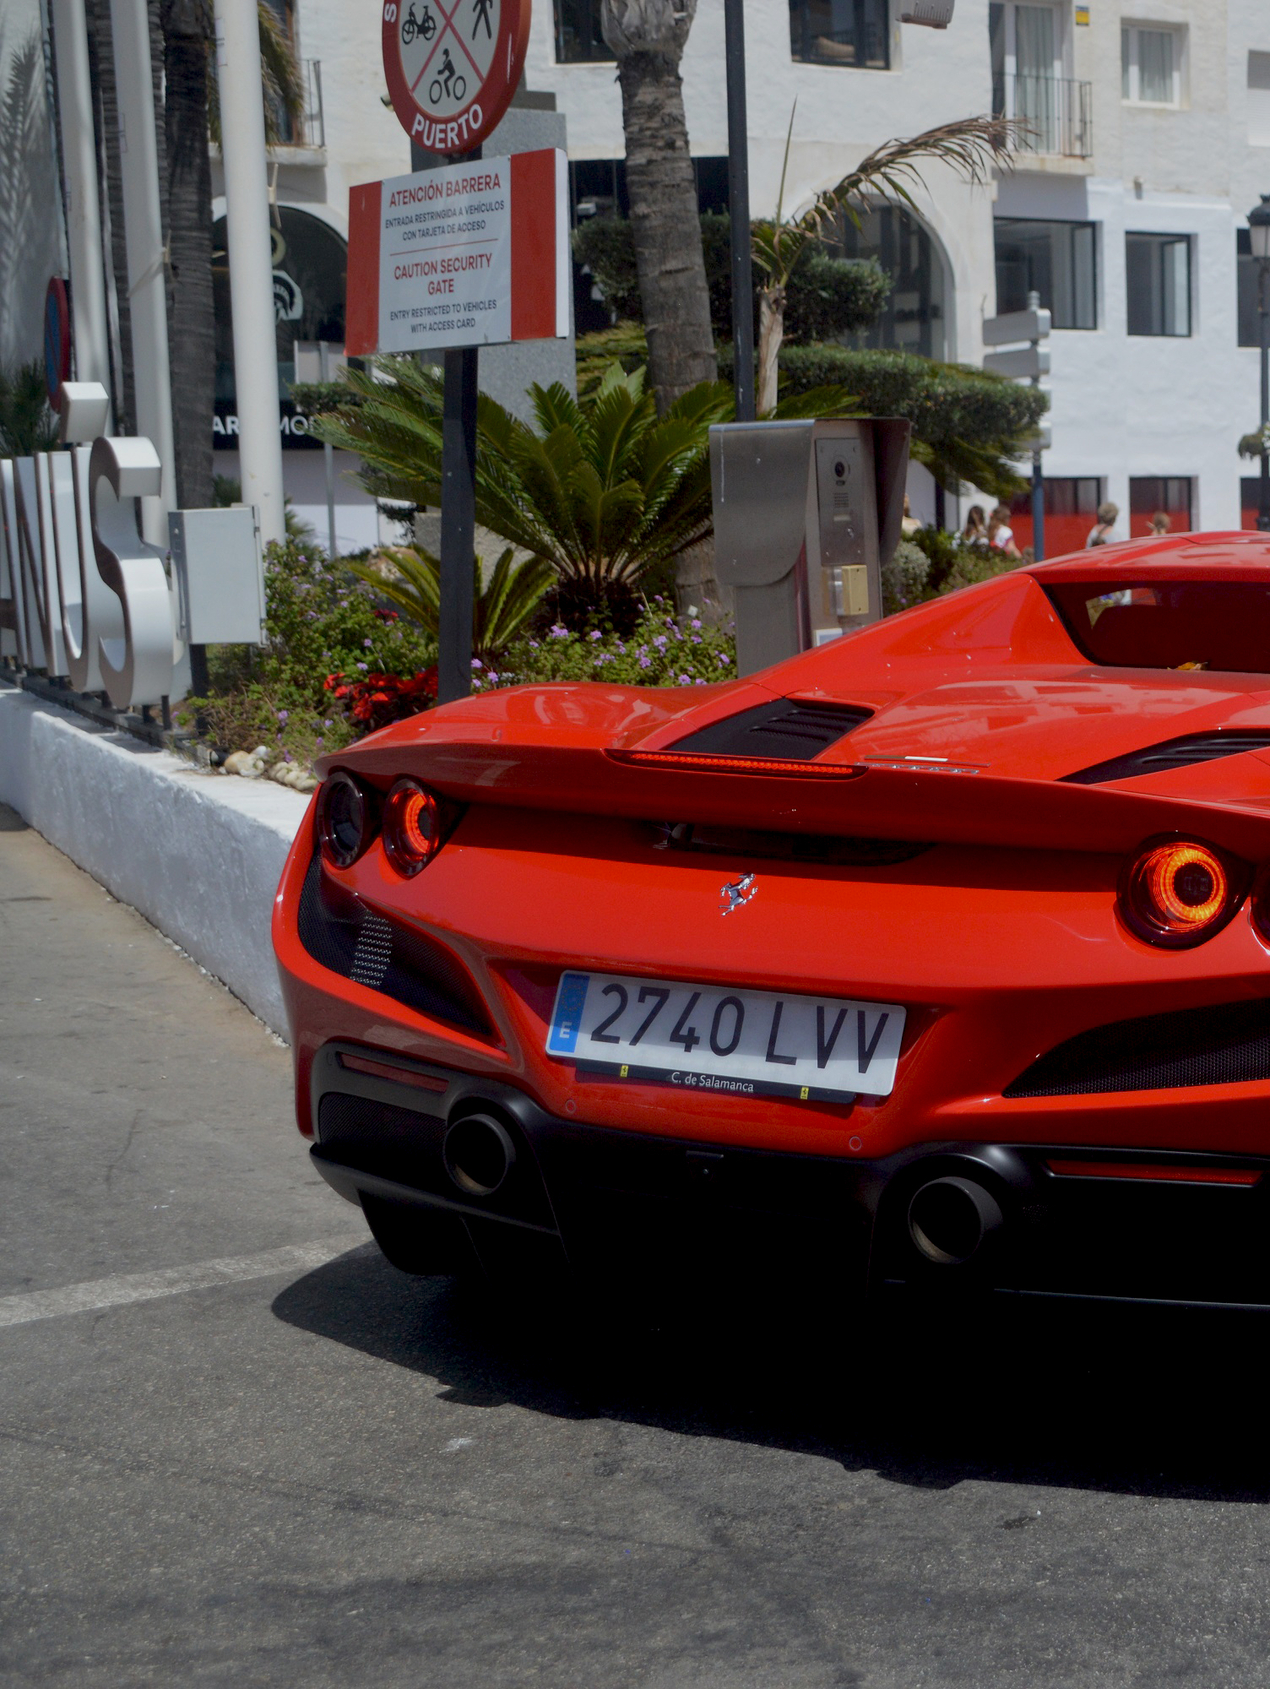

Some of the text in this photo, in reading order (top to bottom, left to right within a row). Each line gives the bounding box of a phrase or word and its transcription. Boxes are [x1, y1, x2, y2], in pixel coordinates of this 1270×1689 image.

[411, 104, 483, 149] PUERTO
[389, 173, 501, 208] ATENCIÓN BARRERA
[385, 200, 504, 229] ENTRADA RESTRINGIDA A VEHÍCULOS
[402, 220, 486, 241] CON TARJETA DE ACCESO
[394, 253, 493, 280] CAUTION SECURITY
[428, 278, 455, 296] GATE
[390, 299, 497, 321] ENTRY RESTRICTED TO VEHICLES
[411, 317, 475, 333] WITH ACCESS CARD
[559, 1021, 572, 1039] E
[590, 983, 889, 1074] 2740 LVV
[671, 1072, 754, 1092] C. de Salamanca
